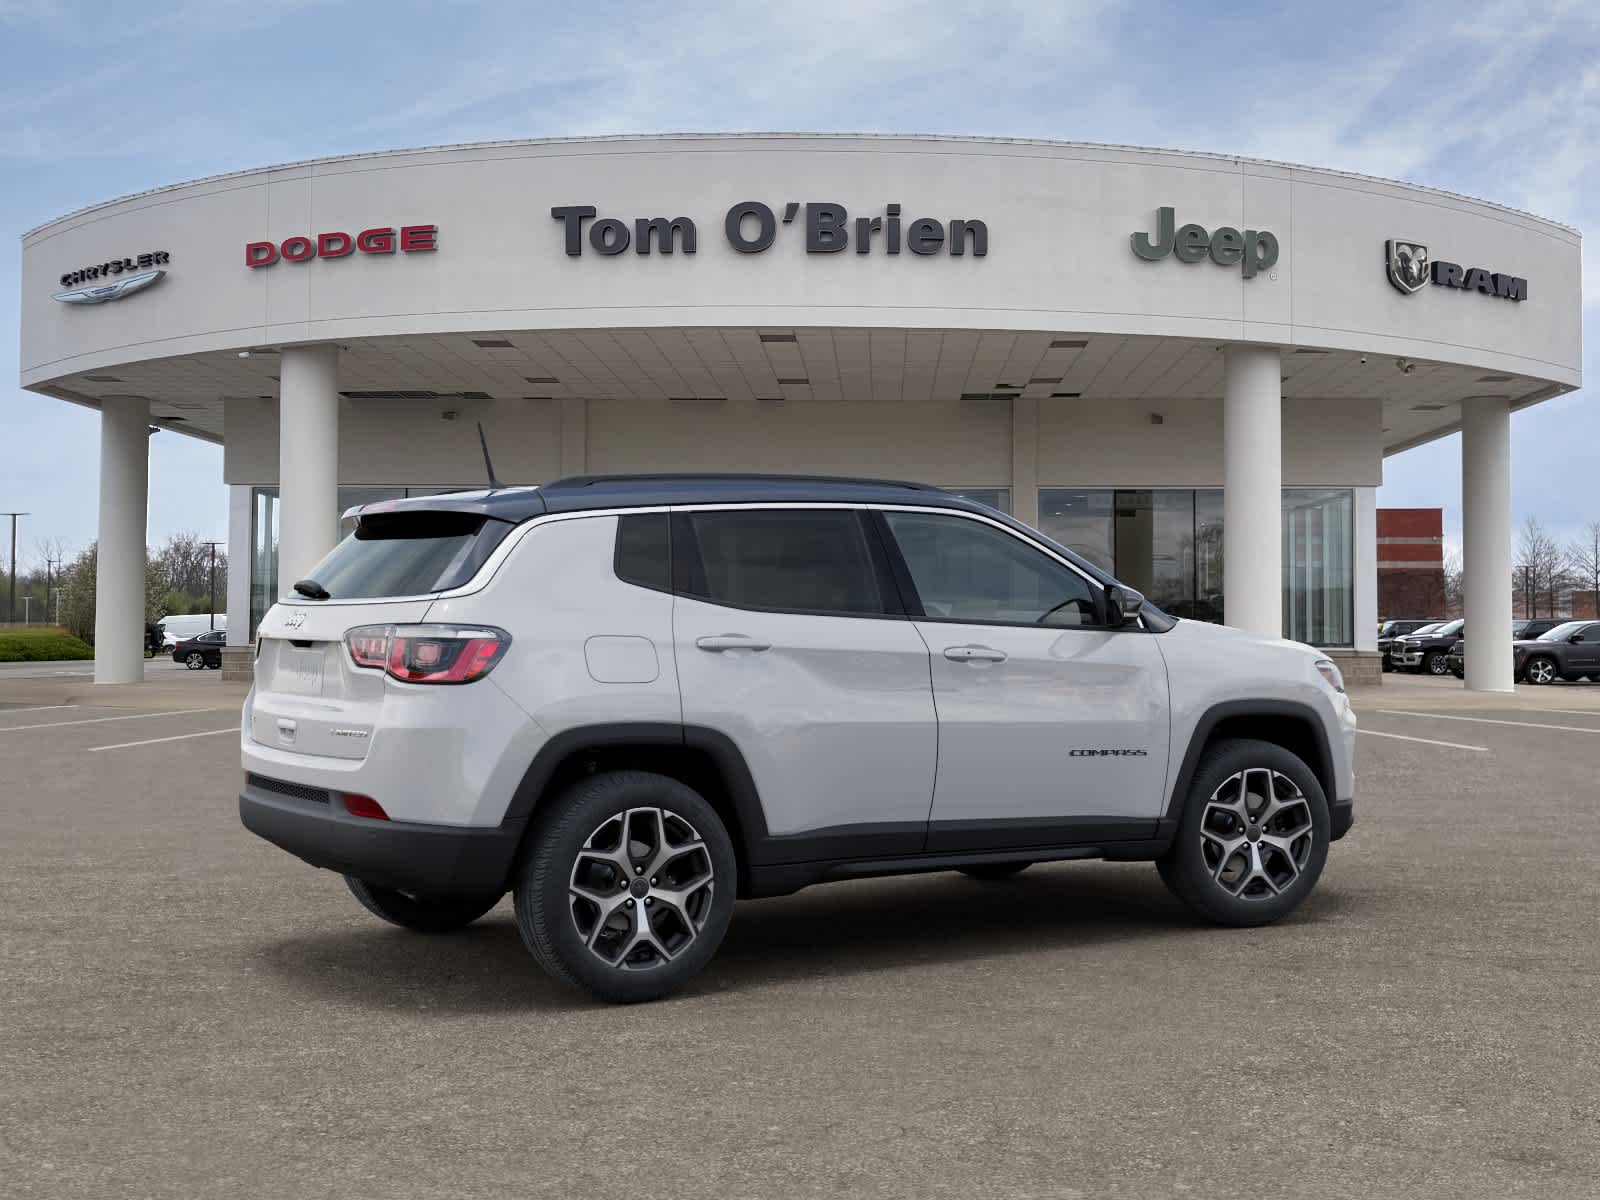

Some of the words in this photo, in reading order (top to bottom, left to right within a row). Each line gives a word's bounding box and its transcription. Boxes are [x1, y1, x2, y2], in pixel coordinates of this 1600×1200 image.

[245, 225, 438, 270] DODGE
[550, 204, 697, 257] Tom
[724, 200, 989, 257] O'Brien
[1130, 206, 1279, 280] Jeep
[60, 250, 170, 287] CHRYSLER
[1430, 260, 1528, 302] RAM
[1069, 749, 1148, 758] COMPASS
